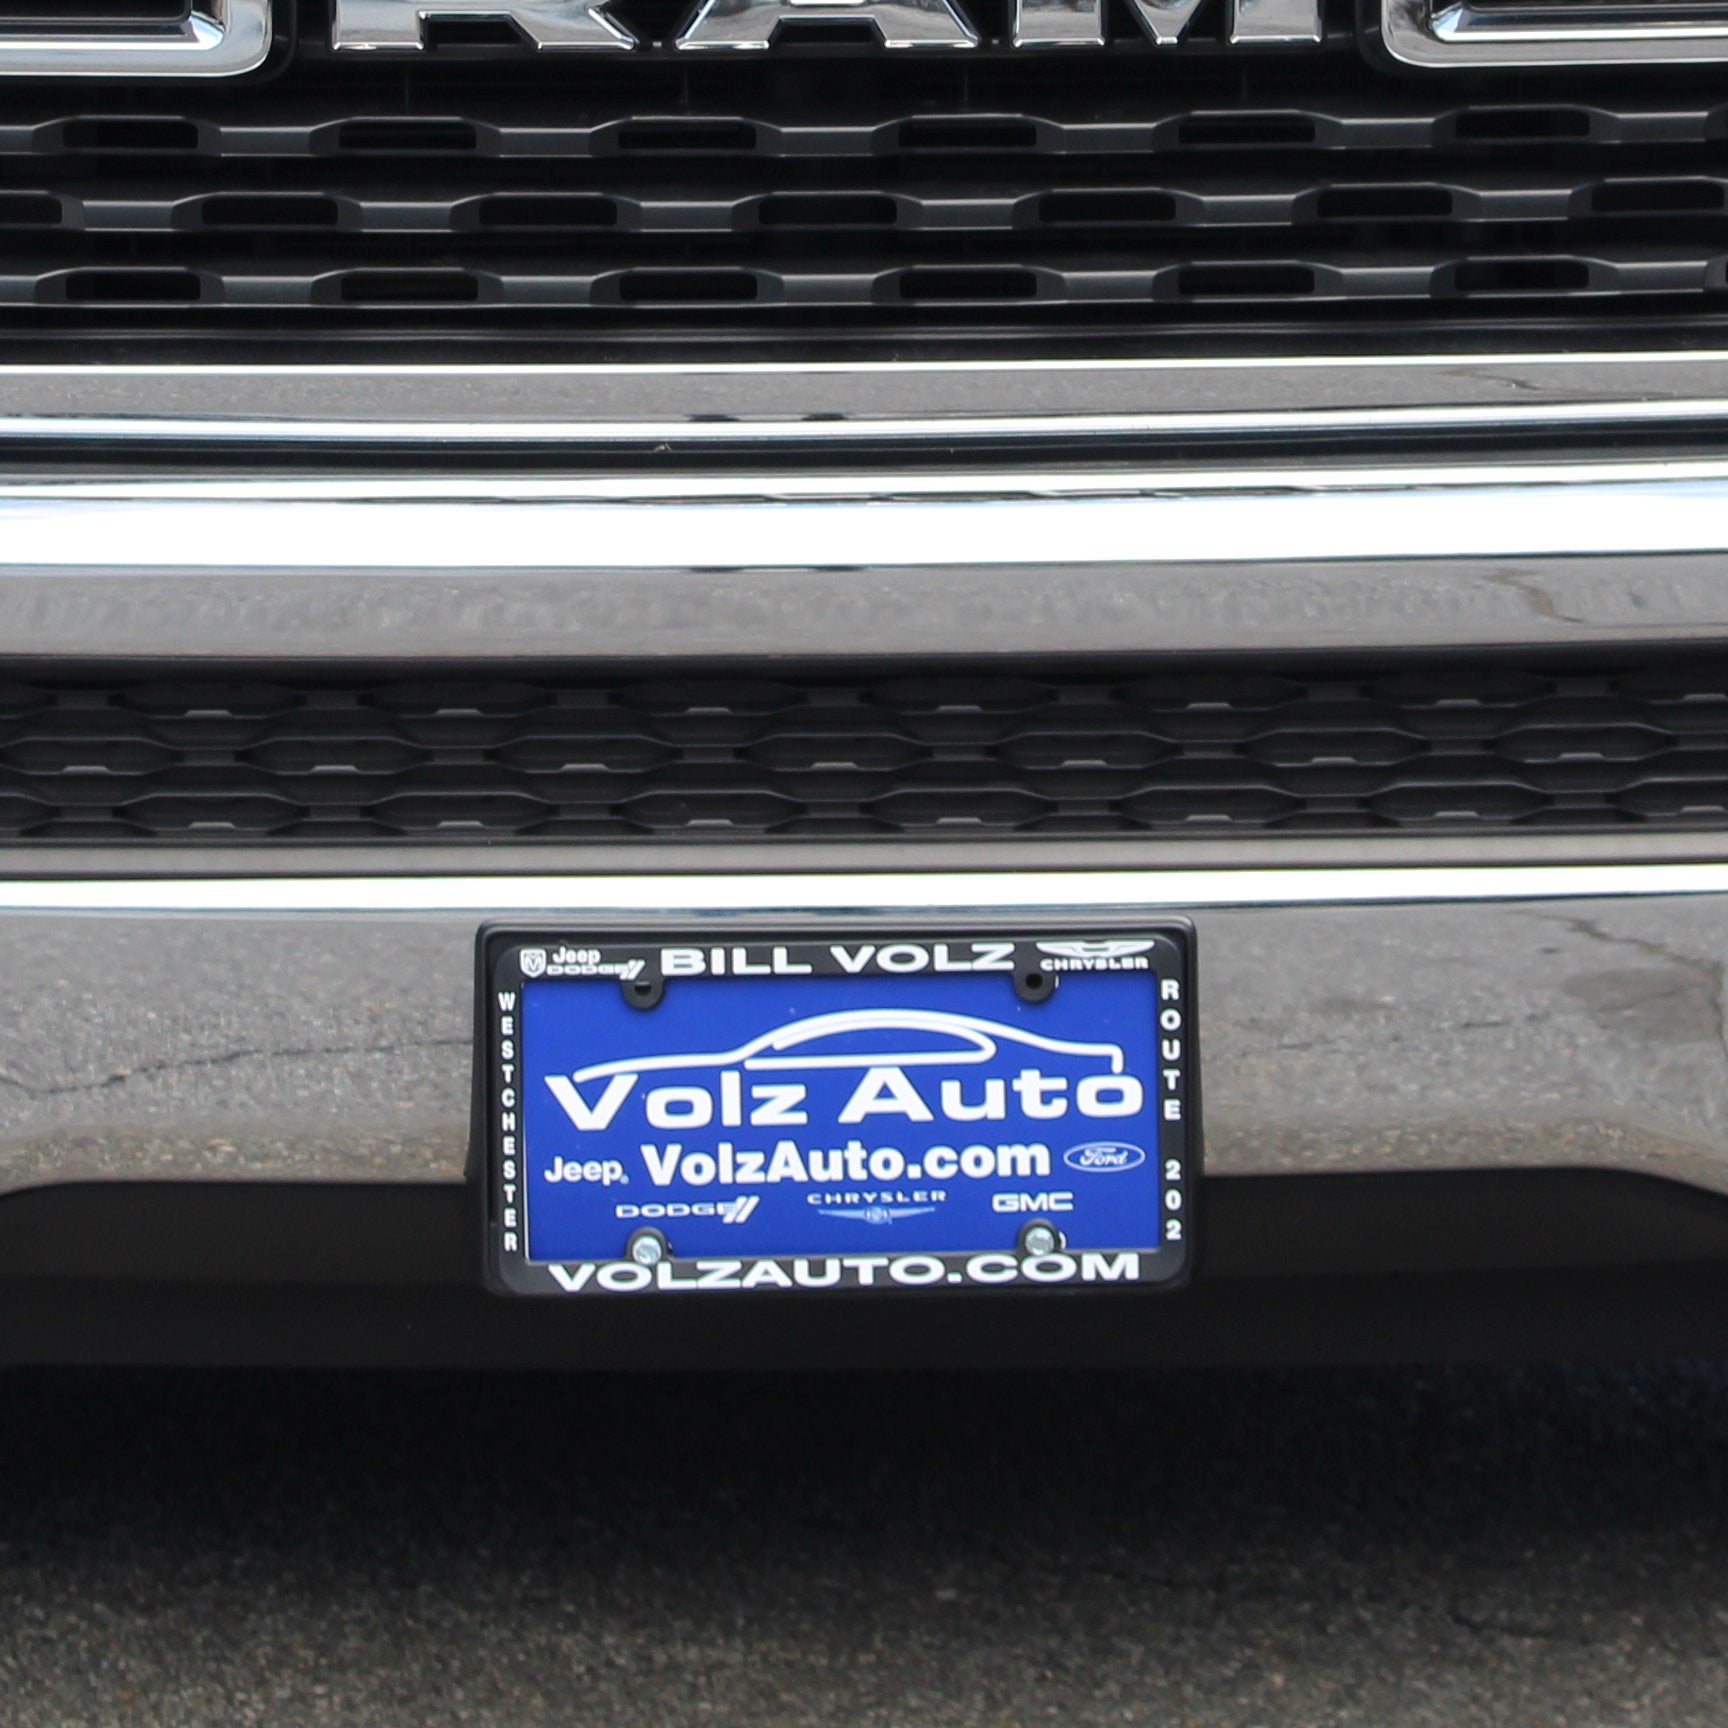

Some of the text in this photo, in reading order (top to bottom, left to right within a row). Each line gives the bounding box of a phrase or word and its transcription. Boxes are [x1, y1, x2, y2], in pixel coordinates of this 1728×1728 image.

[552, 946, 601, 964] Jeep
[661, 943, 1016, 976] BILL VOLZ
[1039, 956, 1150, 972] CHRYSLER
[544, 1067, 1144, 1132] Volz Auto
[1160, 978, 1183, 1241] ROUTE 202
[497, 991, 518, 1252] WESTCHESTER
[641, 1139, 1052, 1187] VolzAuto.com
[1078, 1146, 1130, 1166] Ford
[615, 1202, 735, 1219] DODGE
[806, 1190, 947, 1205] CHRYSLER
[992, 1191, 1074, 1213] GMC
[547, 1251, 1140, 1293] VOLZAUTO.COM
